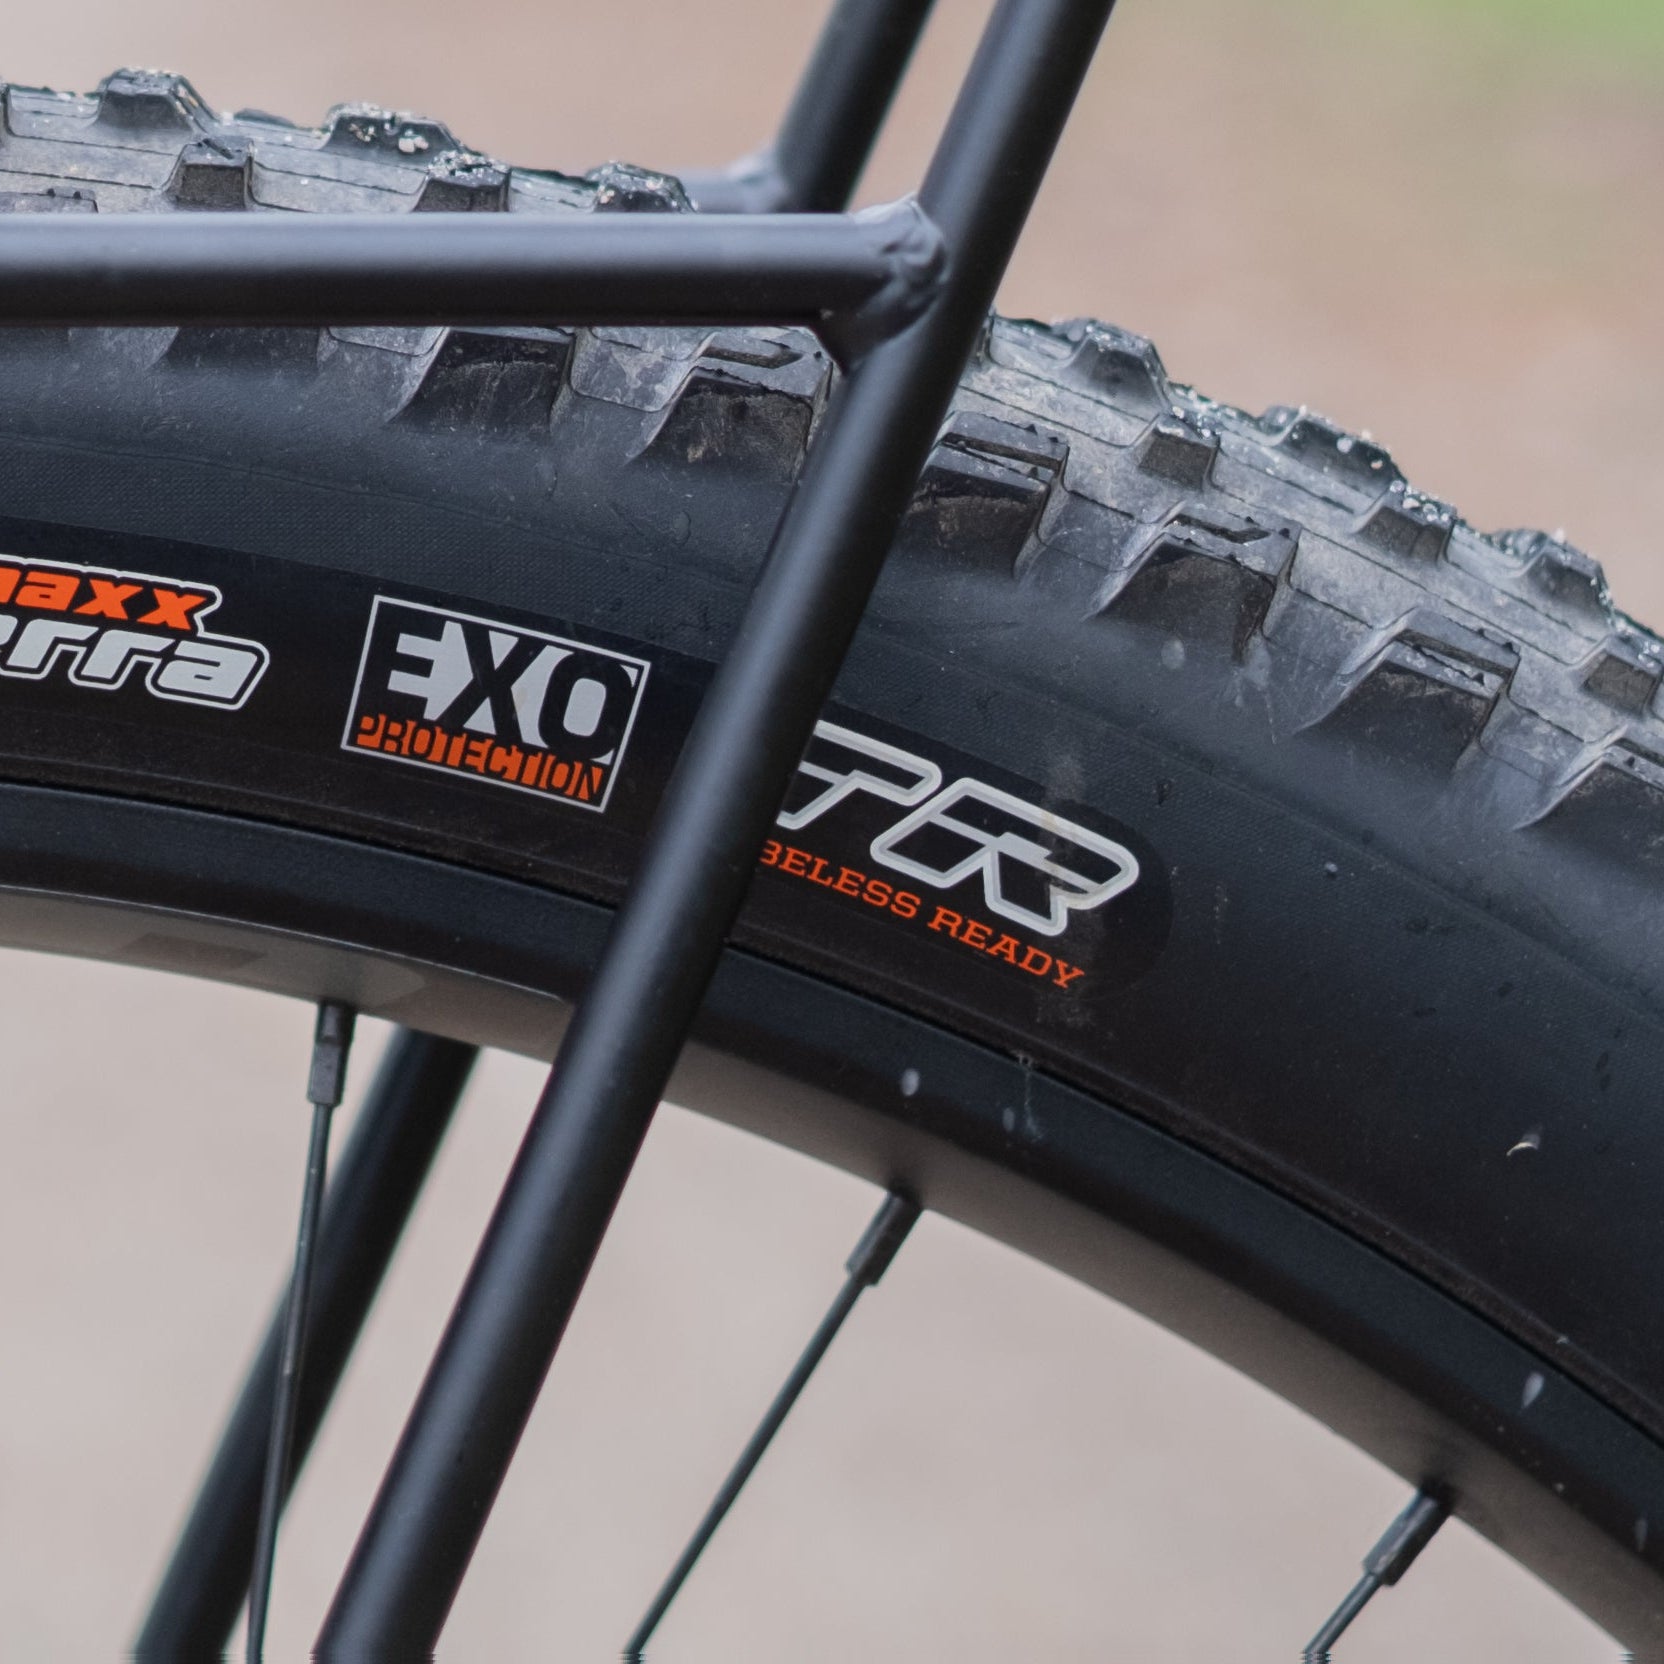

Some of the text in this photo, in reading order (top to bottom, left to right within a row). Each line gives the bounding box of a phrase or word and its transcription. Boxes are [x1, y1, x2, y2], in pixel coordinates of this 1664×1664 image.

[366, 604, 640, 766] EXO
[354, 710, 606, 804] PROTECTION
[776, 719, 1139, 936] TR
[927, 905, 1086, 989] READY
